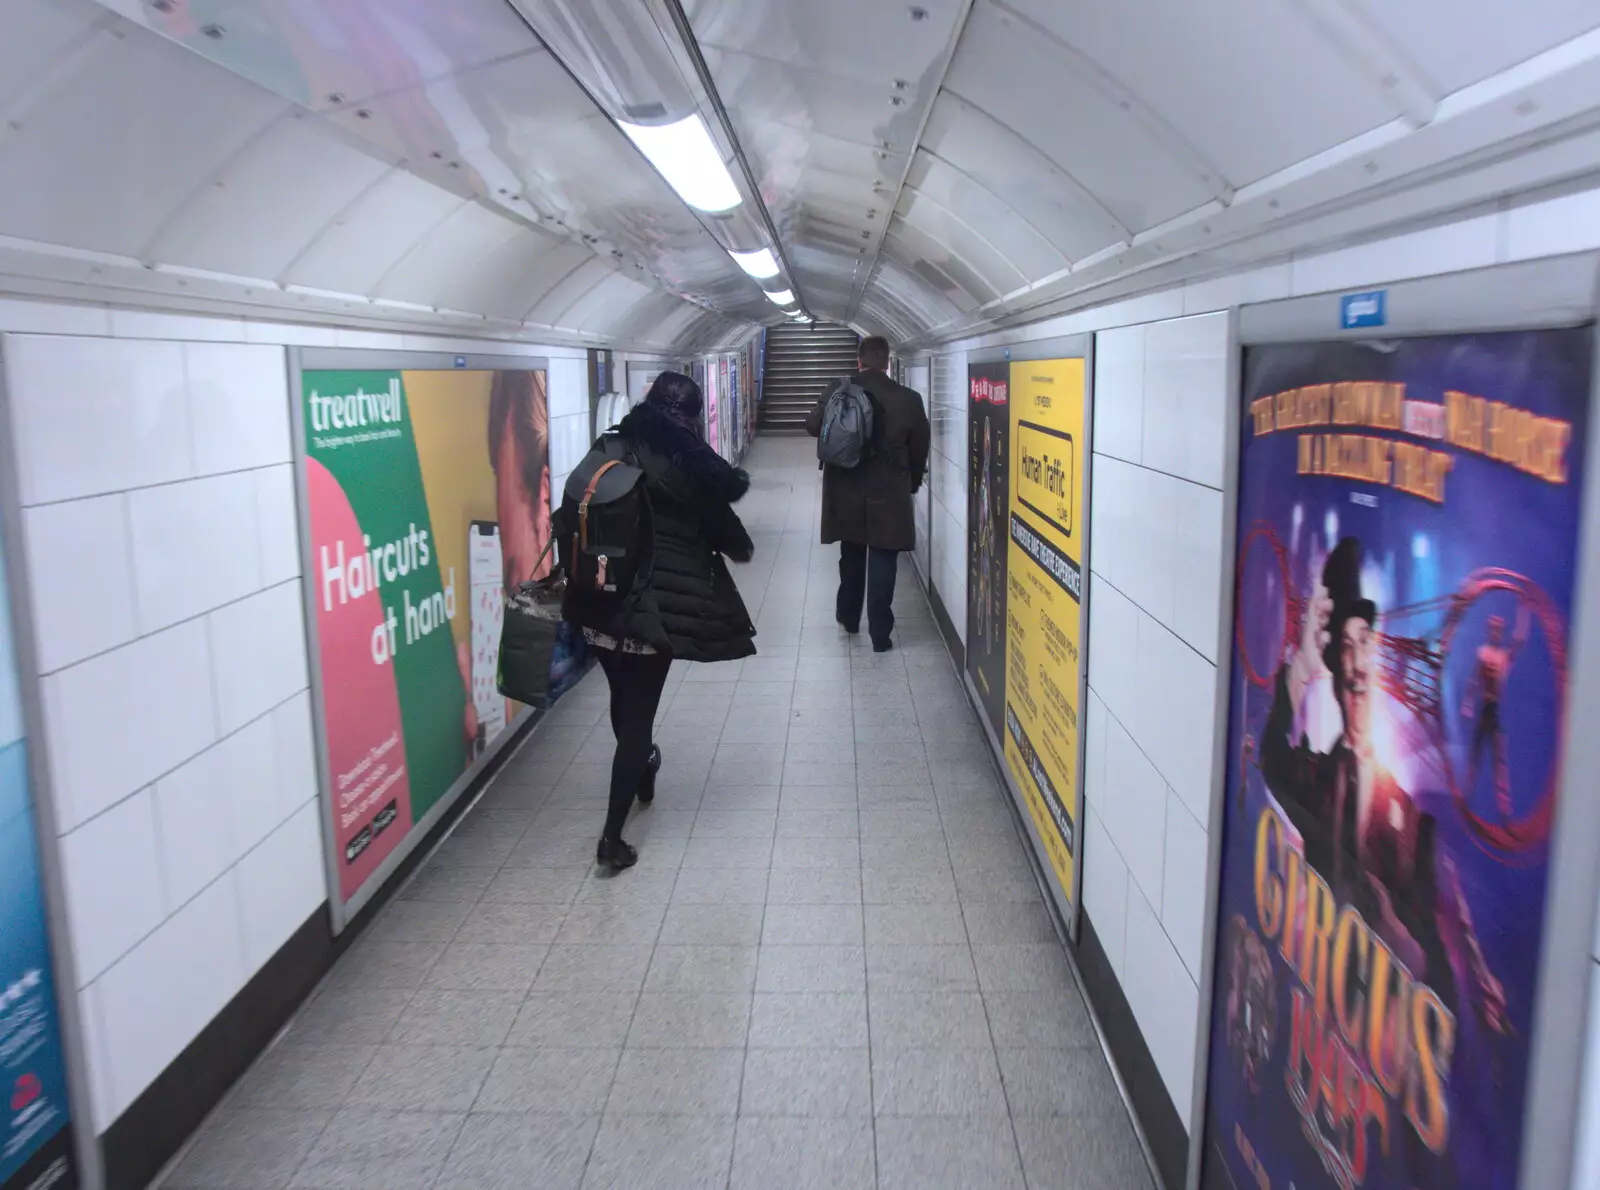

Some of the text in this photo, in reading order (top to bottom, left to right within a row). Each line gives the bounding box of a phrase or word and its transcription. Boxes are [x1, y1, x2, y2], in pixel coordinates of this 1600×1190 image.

[309, 378, 402, 431] treatwell
[1022, 445, 1042, 485] Human
[1043, 455, 1065, 498] Traffic
[320, 523, 429, 611] Haircuts
[371, 567, 456, 664] at hand
[1255, 806, 1457, 1154] CIRCUS
